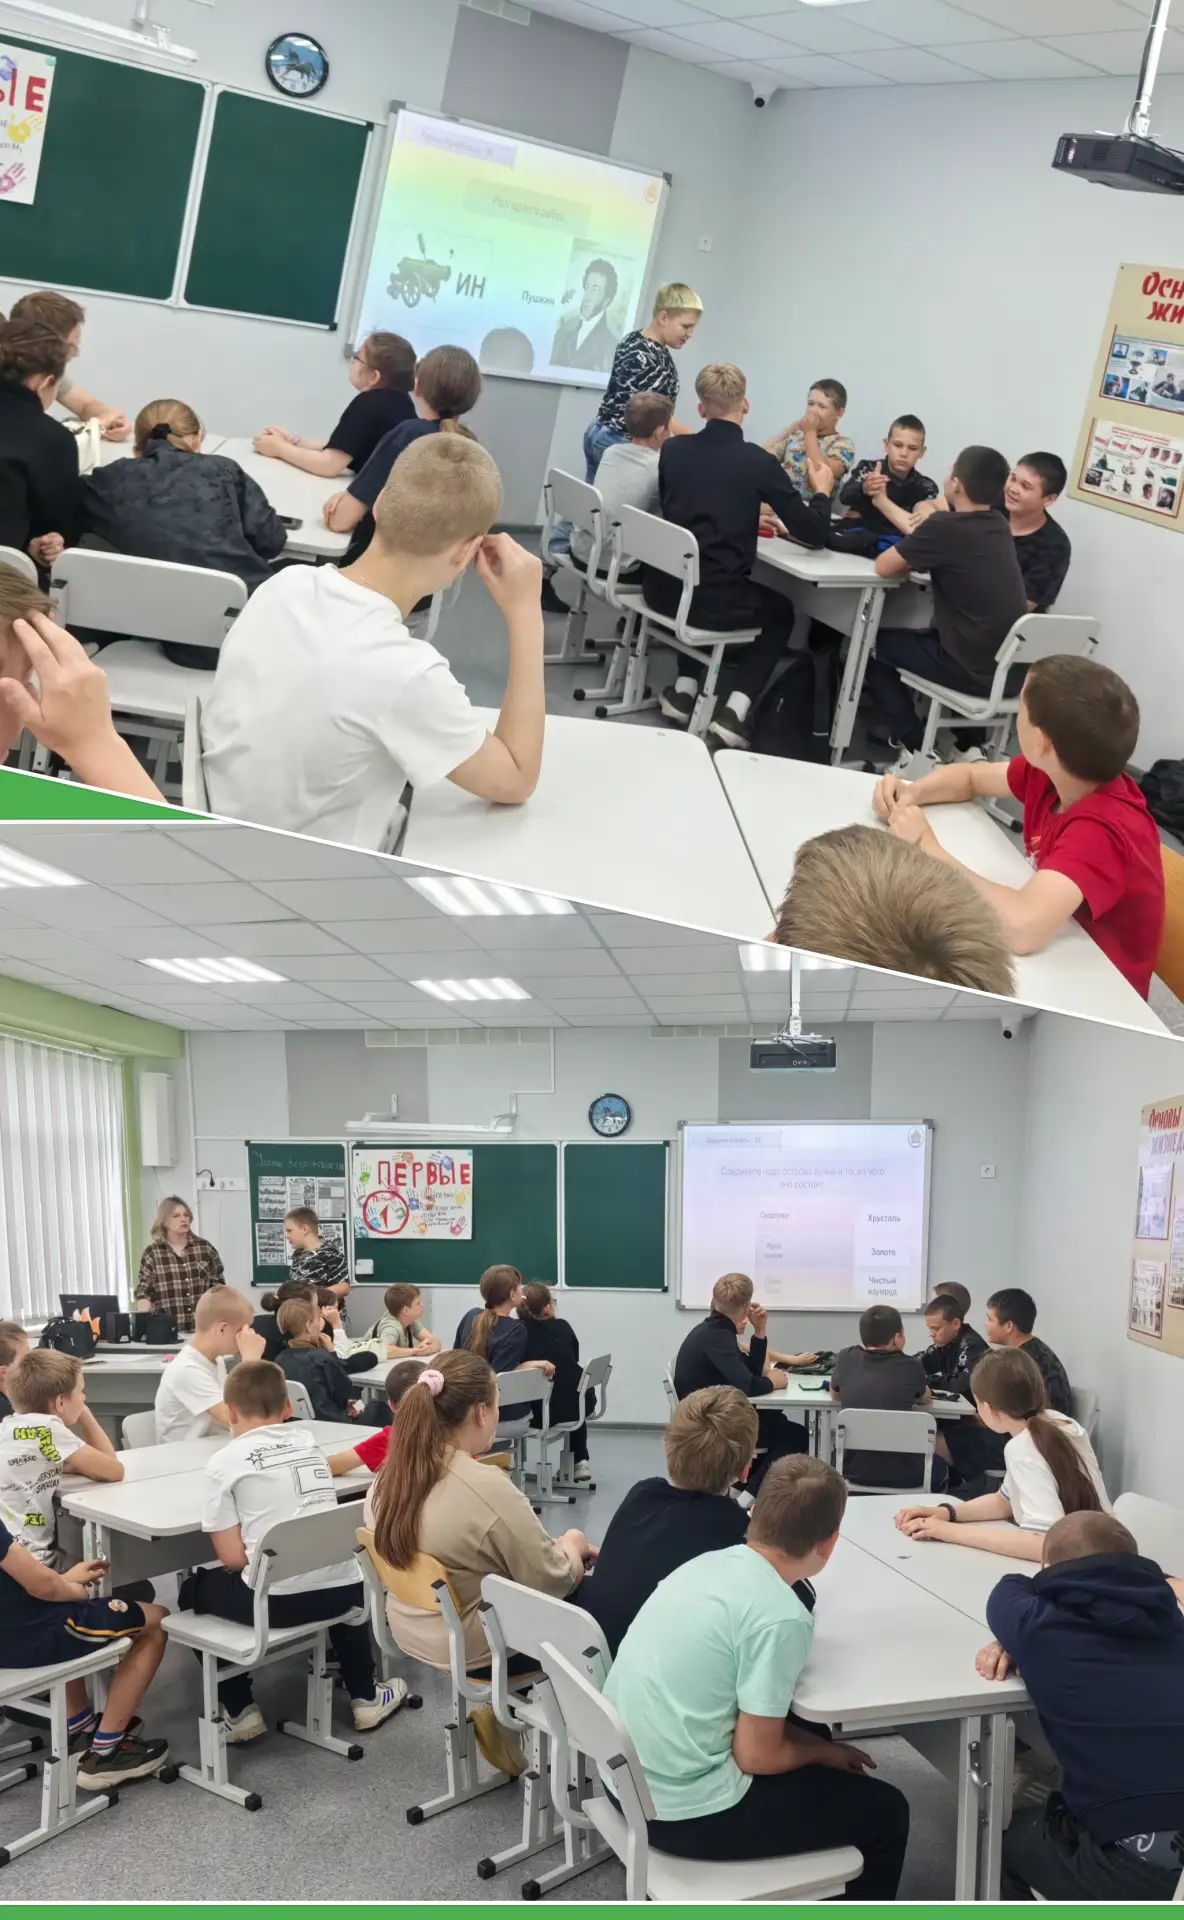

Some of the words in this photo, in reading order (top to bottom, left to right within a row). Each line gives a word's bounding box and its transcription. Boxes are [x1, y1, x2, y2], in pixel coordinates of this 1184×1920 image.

[455, 272, 487, 298] ИН
[521, 289, 555, 305] Пушкин
[378, 1161, 470, 1188] ПЕРВЫЕ
[868, 1214, 901, 1224] Хрусталь
[871, 1248, 896, 1257] Золото
[868, 1275, 897, 1285] Чистый
